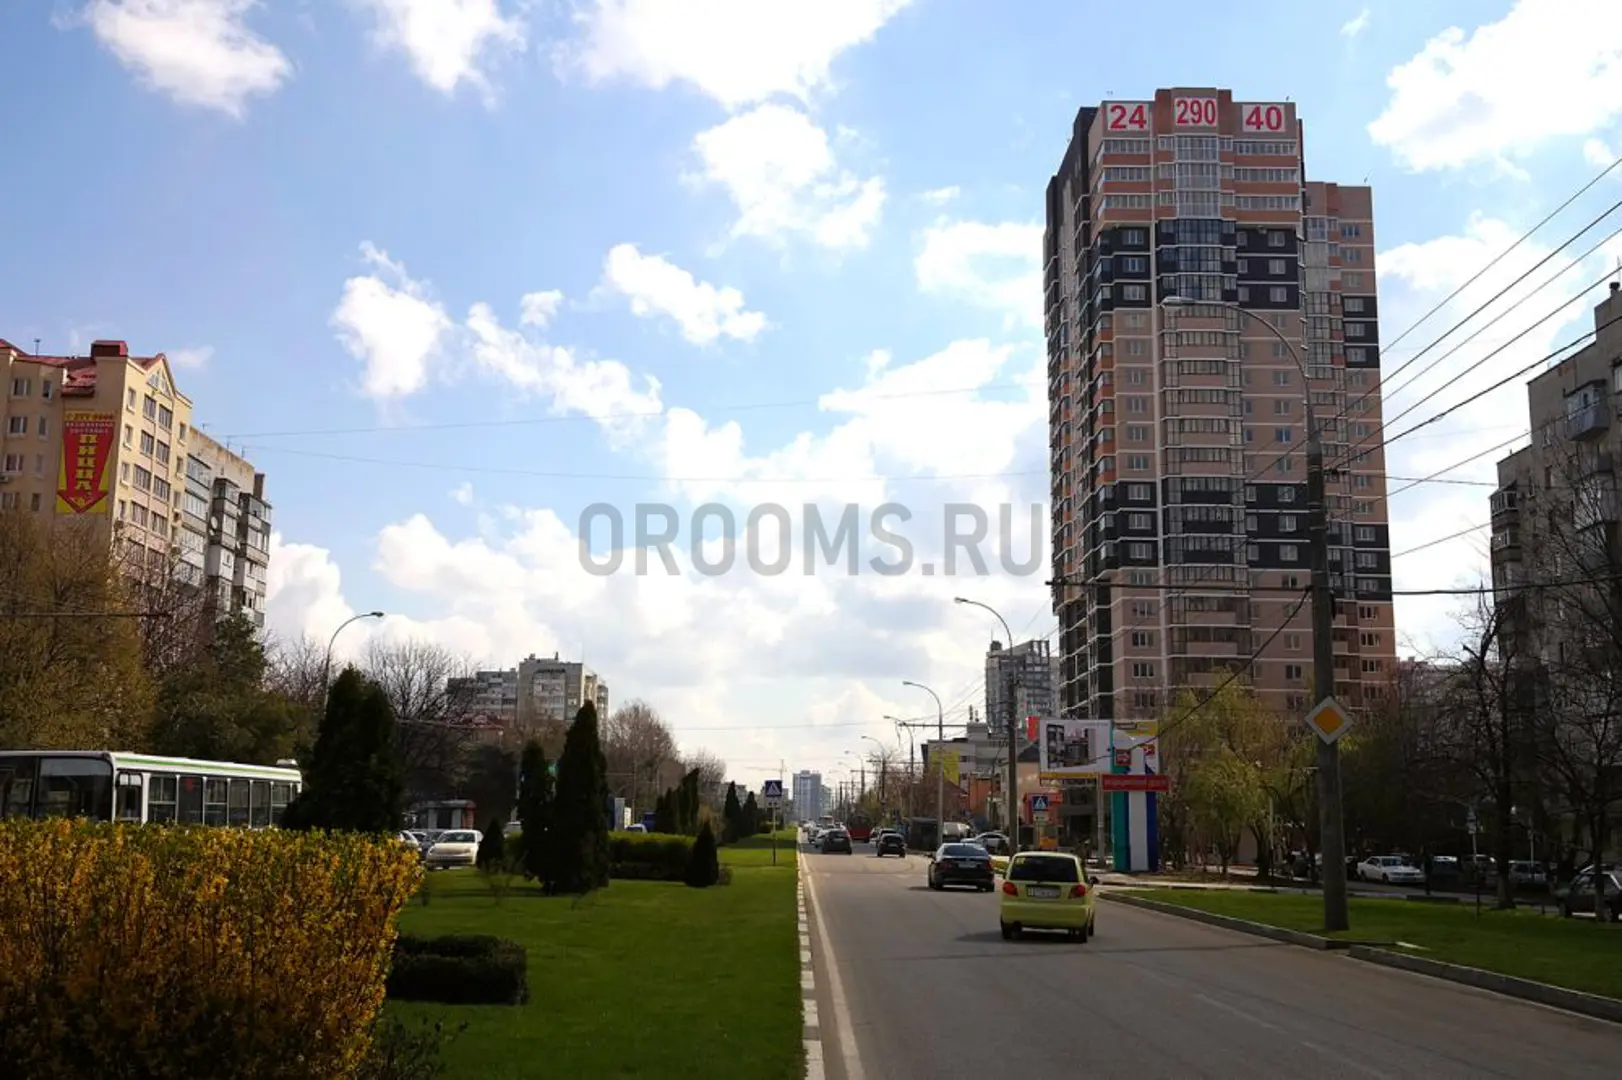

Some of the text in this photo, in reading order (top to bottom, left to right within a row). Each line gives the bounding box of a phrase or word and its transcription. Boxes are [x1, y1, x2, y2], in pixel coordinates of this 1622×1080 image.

[1110, 104, 1147, 129] 24
[1176, 100, 1216, 124] 290
[1245, 105, 1282, 130] 40
